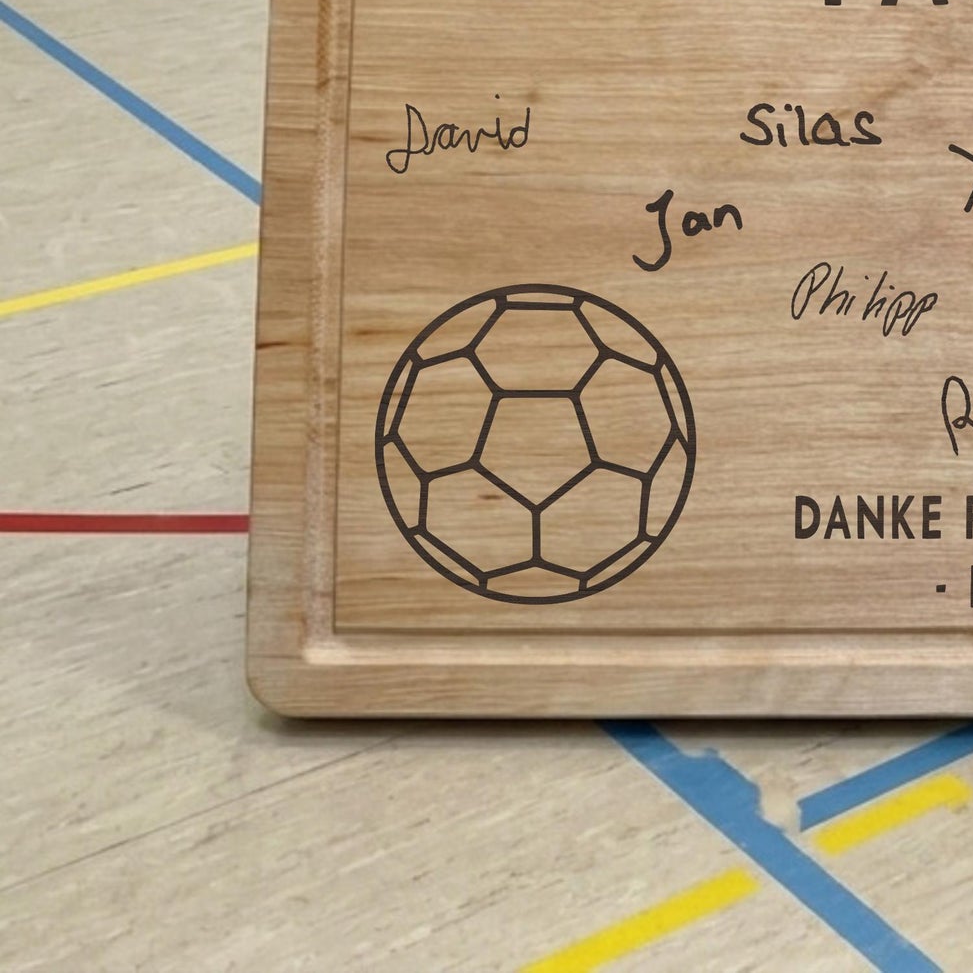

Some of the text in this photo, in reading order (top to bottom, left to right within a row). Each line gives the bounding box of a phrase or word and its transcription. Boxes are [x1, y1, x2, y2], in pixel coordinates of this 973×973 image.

[386, 94, 530, 173] David
[740, 103, 882, 147] Silas
[633, 190, 742, 271] Jan
[791, 262, 938, 336] Philipp
[795, 496, 941, 539] DANKE
